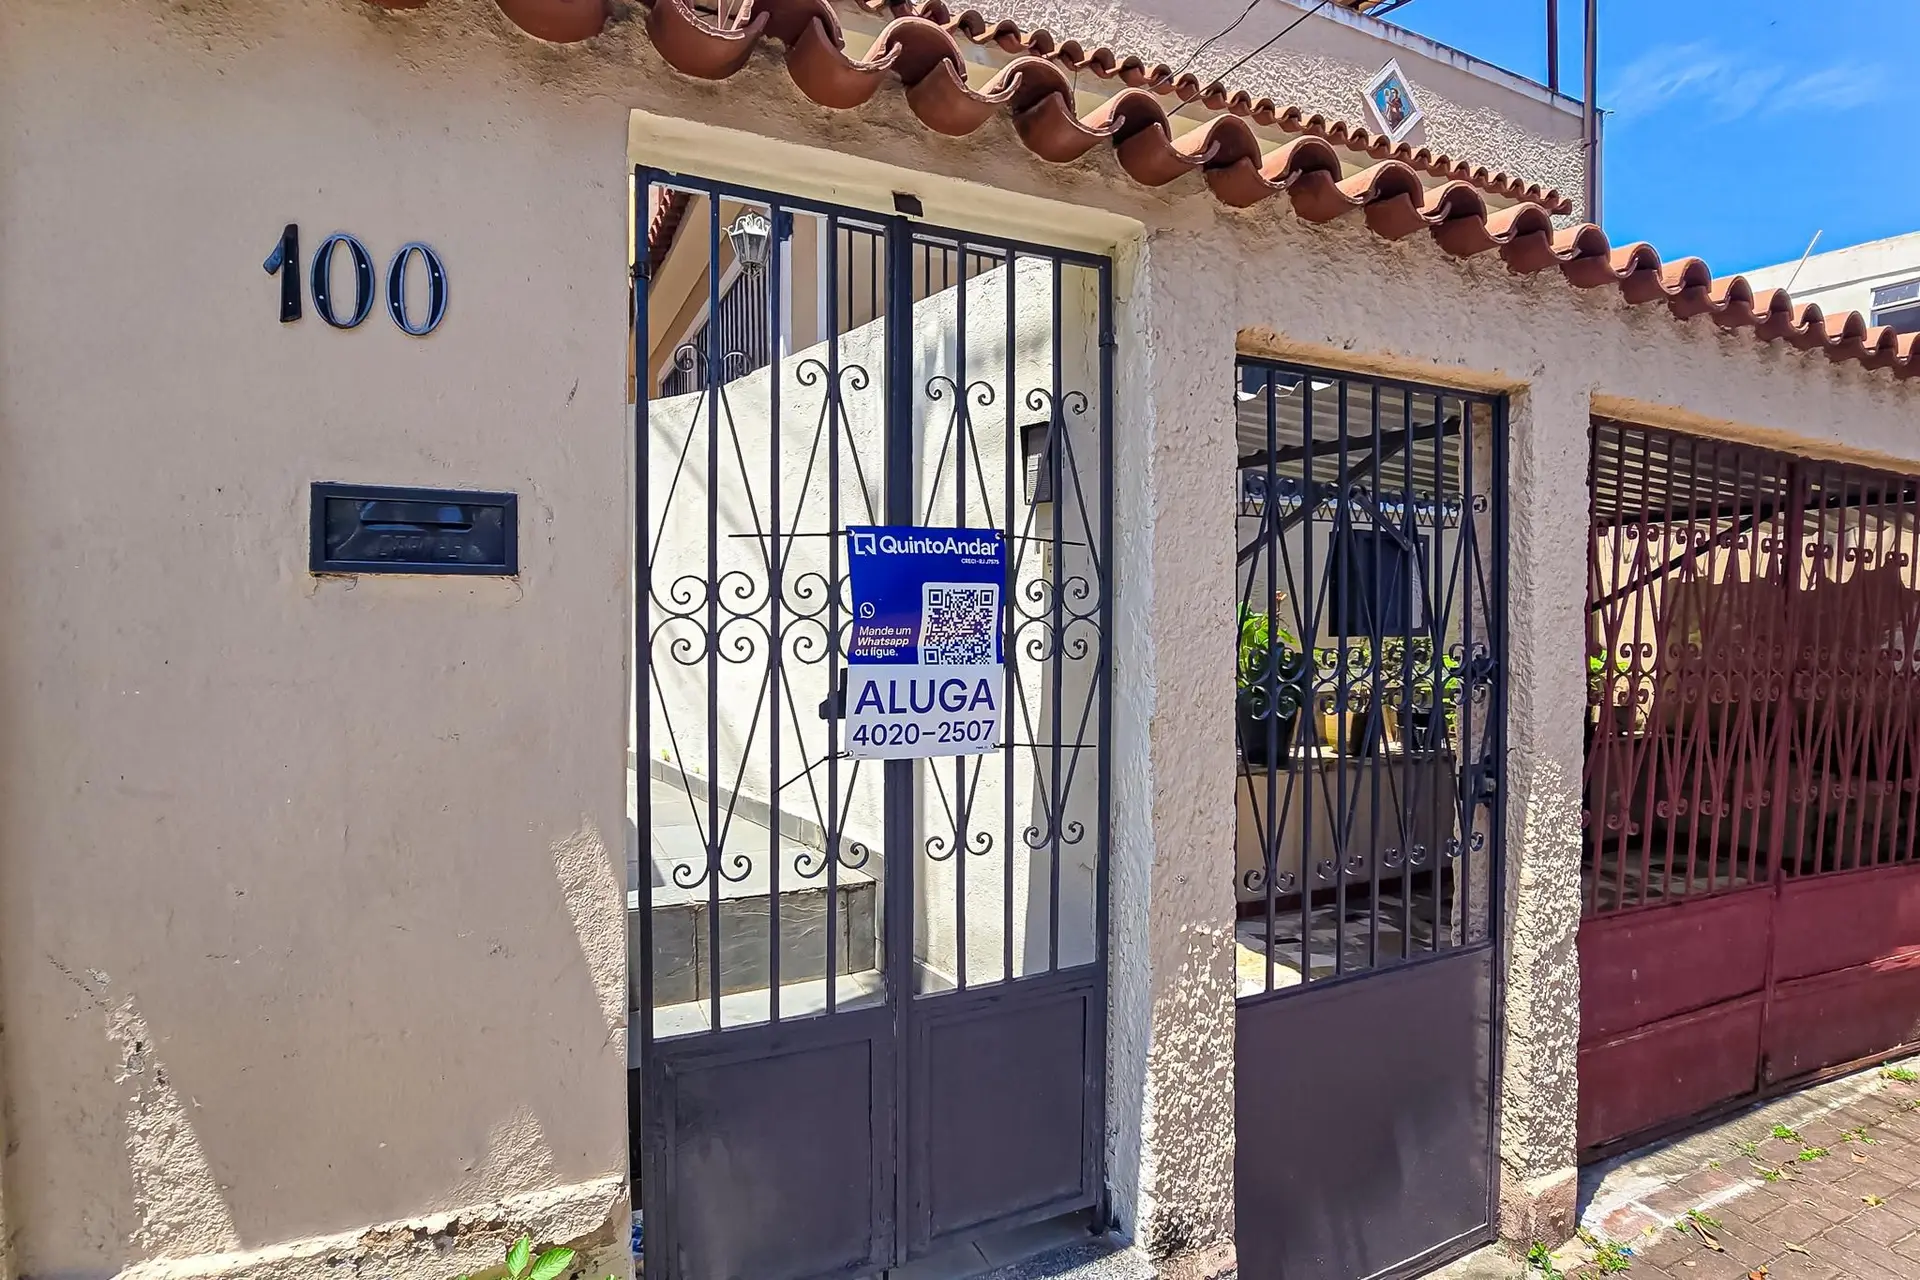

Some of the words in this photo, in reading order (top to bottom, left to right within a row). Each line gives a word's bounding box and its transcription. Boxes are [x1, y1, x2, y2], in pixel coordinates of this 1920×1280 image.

[263, 223, 449, 336] 100
[879, 535, 999, 556] QuintoAndar
[857, 636, 909, 647] Whatsapp
[859, 626, 894, 636] Mande
[895, 628, 912, 636] um
[855, 648, 868, 657] ou
[869, 647, 898, 658] ligue.
[854, 678, 996, 715] ALUGA
[852, 720, 995, 746] 4020-2507
